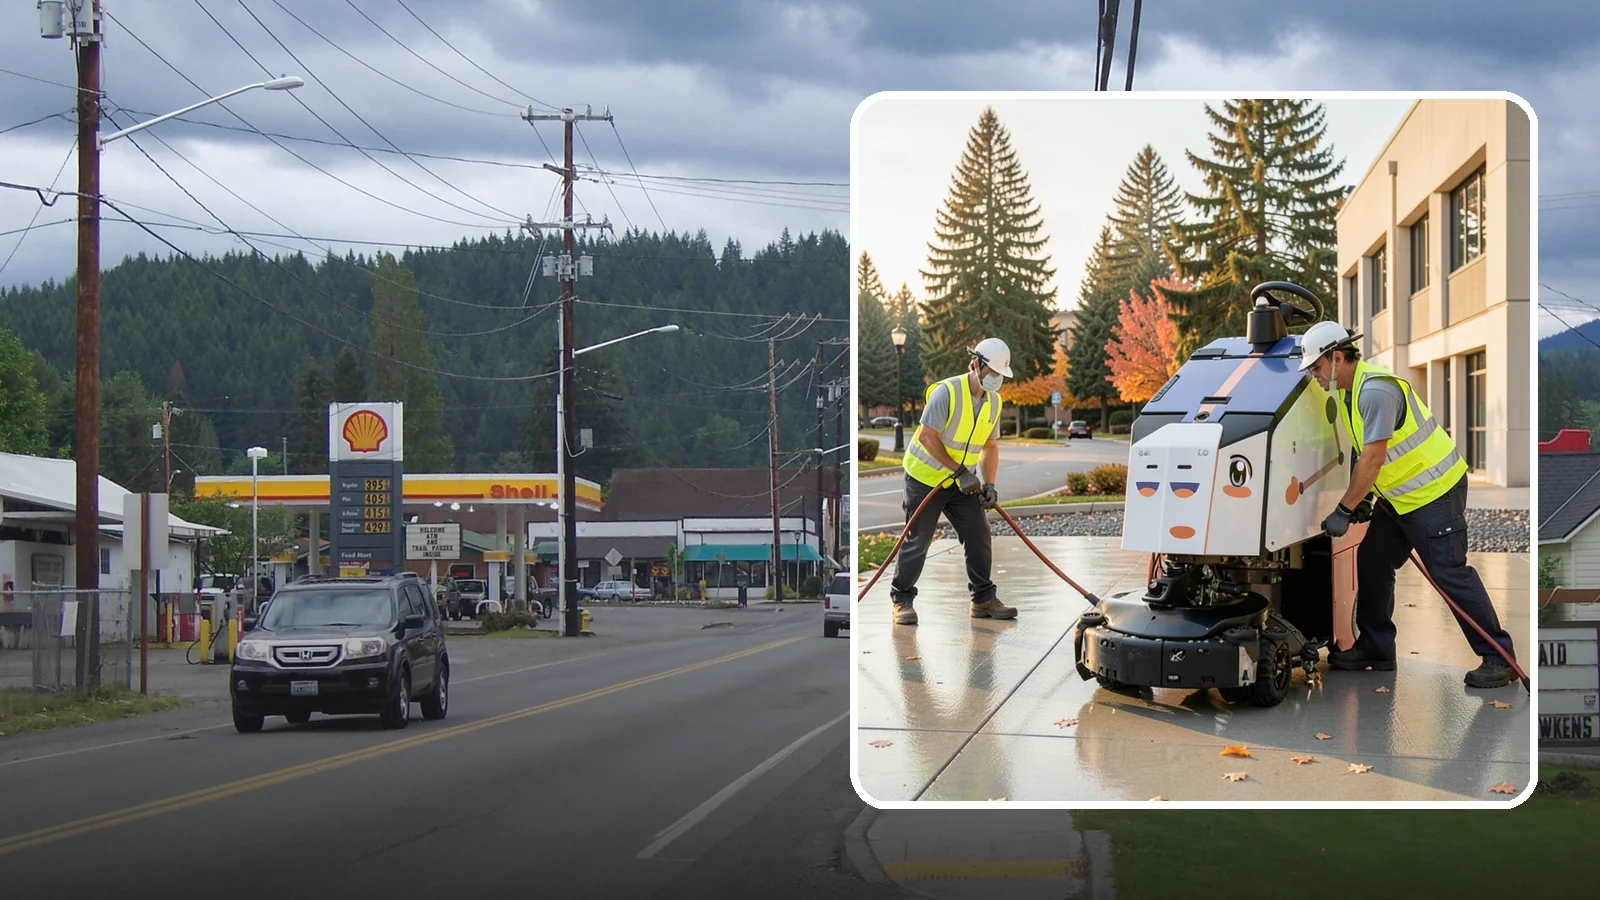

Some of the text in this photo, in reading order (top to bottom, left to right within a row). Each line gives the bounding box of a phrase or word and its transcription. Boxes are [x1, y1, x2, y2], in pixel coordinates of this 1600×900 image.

[366, 480, 383, 490] 395
[490, 484, 547, 499] Shell
[366, 494, 383, 504] 405
[366, 508, 383, 518] 415
[366, 522, 383, 533] 429
